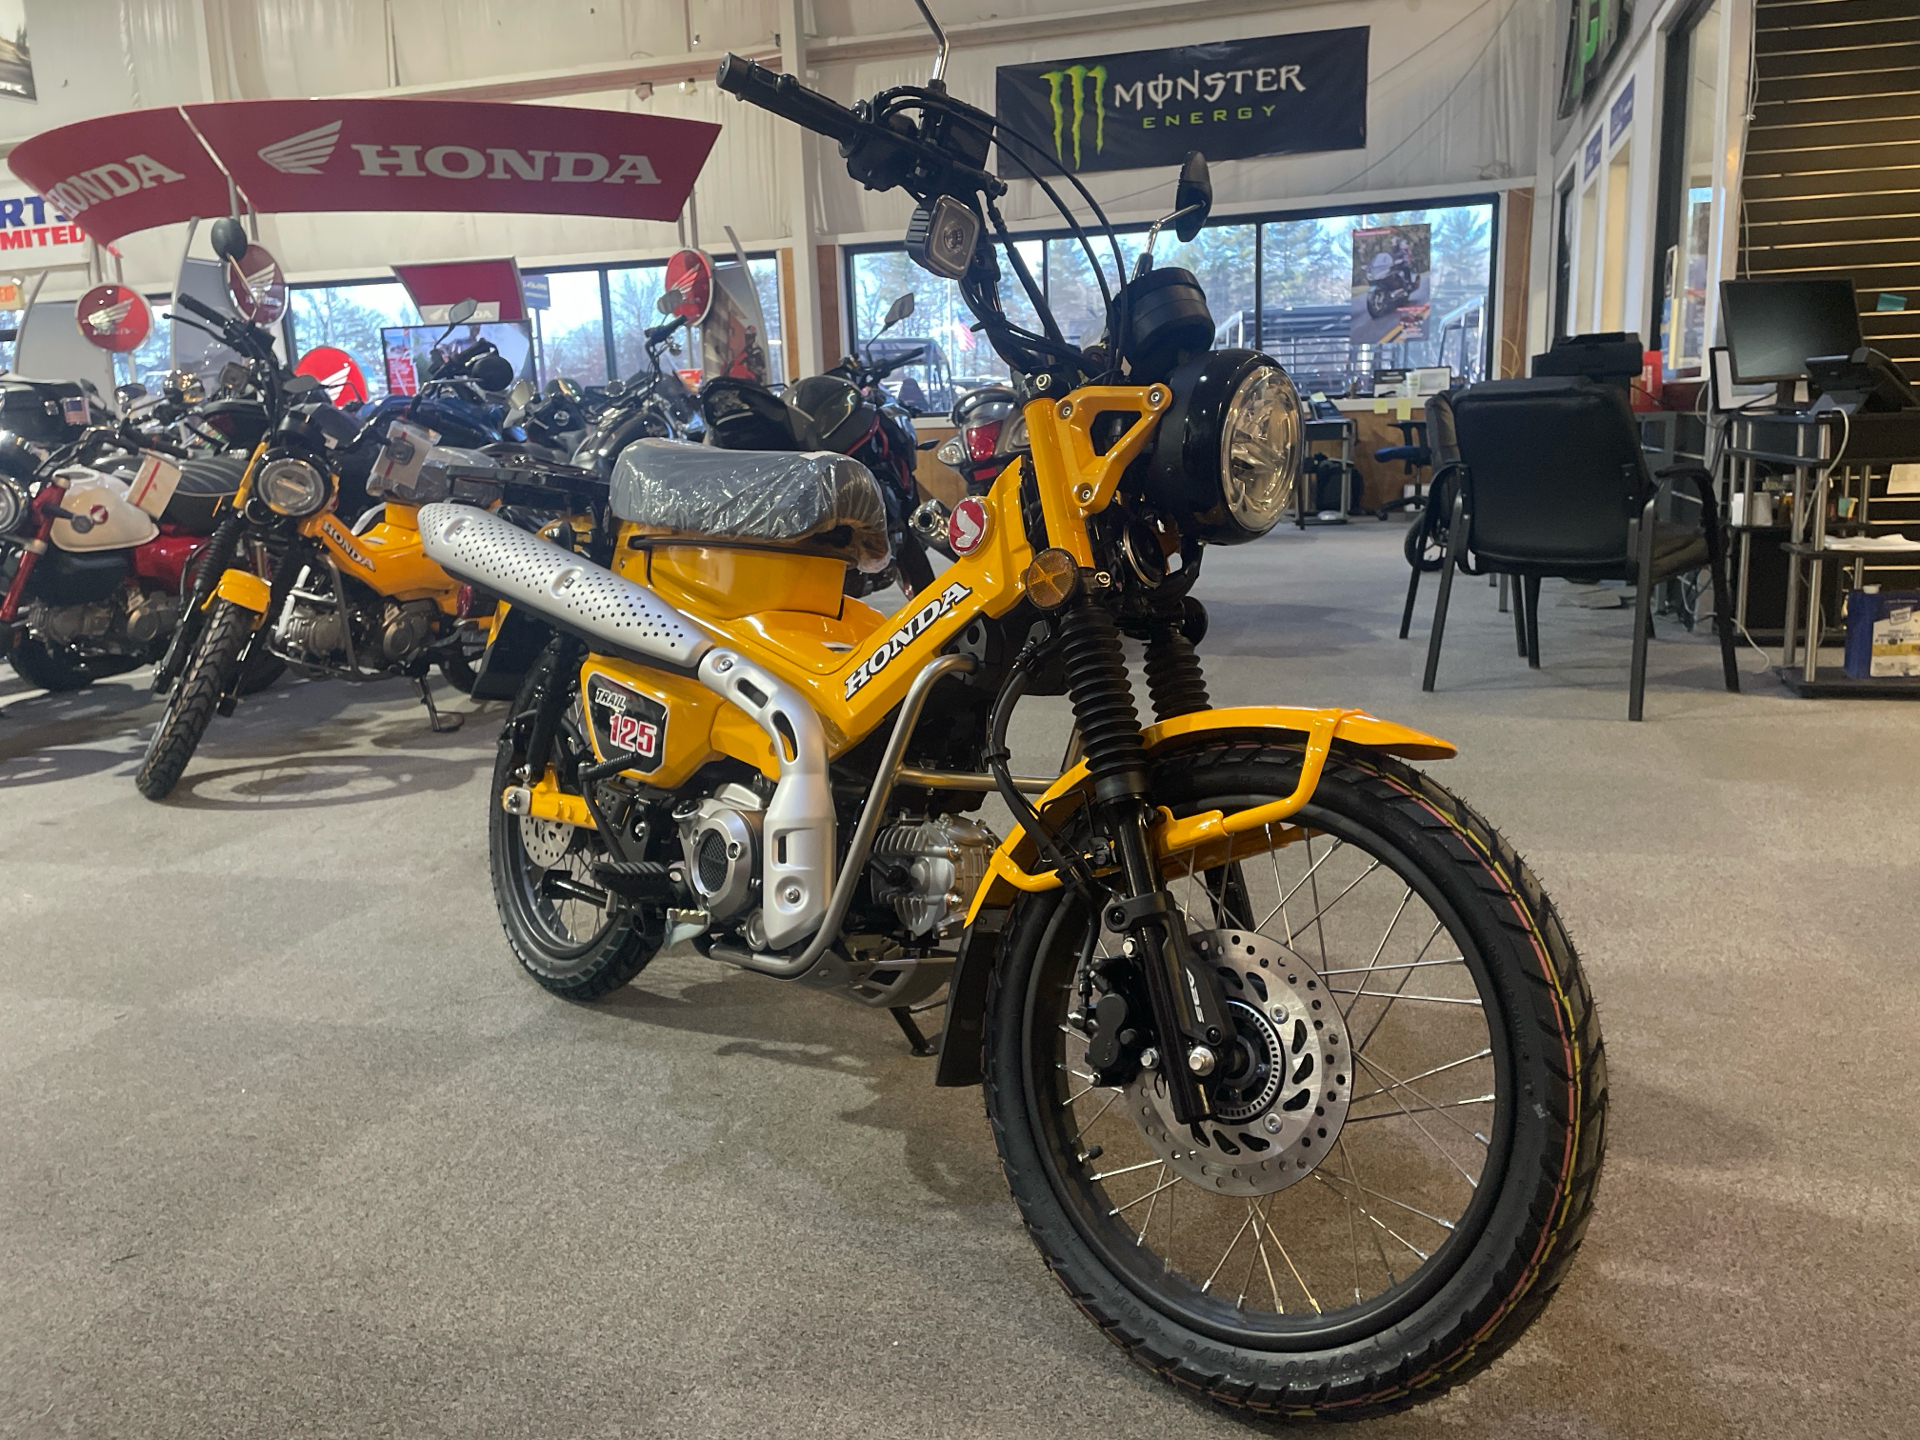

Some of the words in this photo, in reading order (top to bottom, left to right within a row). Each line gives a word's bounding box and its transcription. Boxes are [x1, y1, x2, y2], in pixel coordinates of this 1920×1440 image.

[1114, 64, 1306, 111] MONSTER
[1142, 104, 1276, 129] ENERGY
[46, 153, 187, 219] HONDA
[350, 143, 662, 185] HONDA
[0, 195, 68, 229] RT
[322, 520, 377, 573] HONDA
[844, 581, 973, 701] HONDA
[594, 687, 627, 712] TRAIL
[609, 712, 658, 758] 125
[1185, 966, 1205, 1024] ABS
